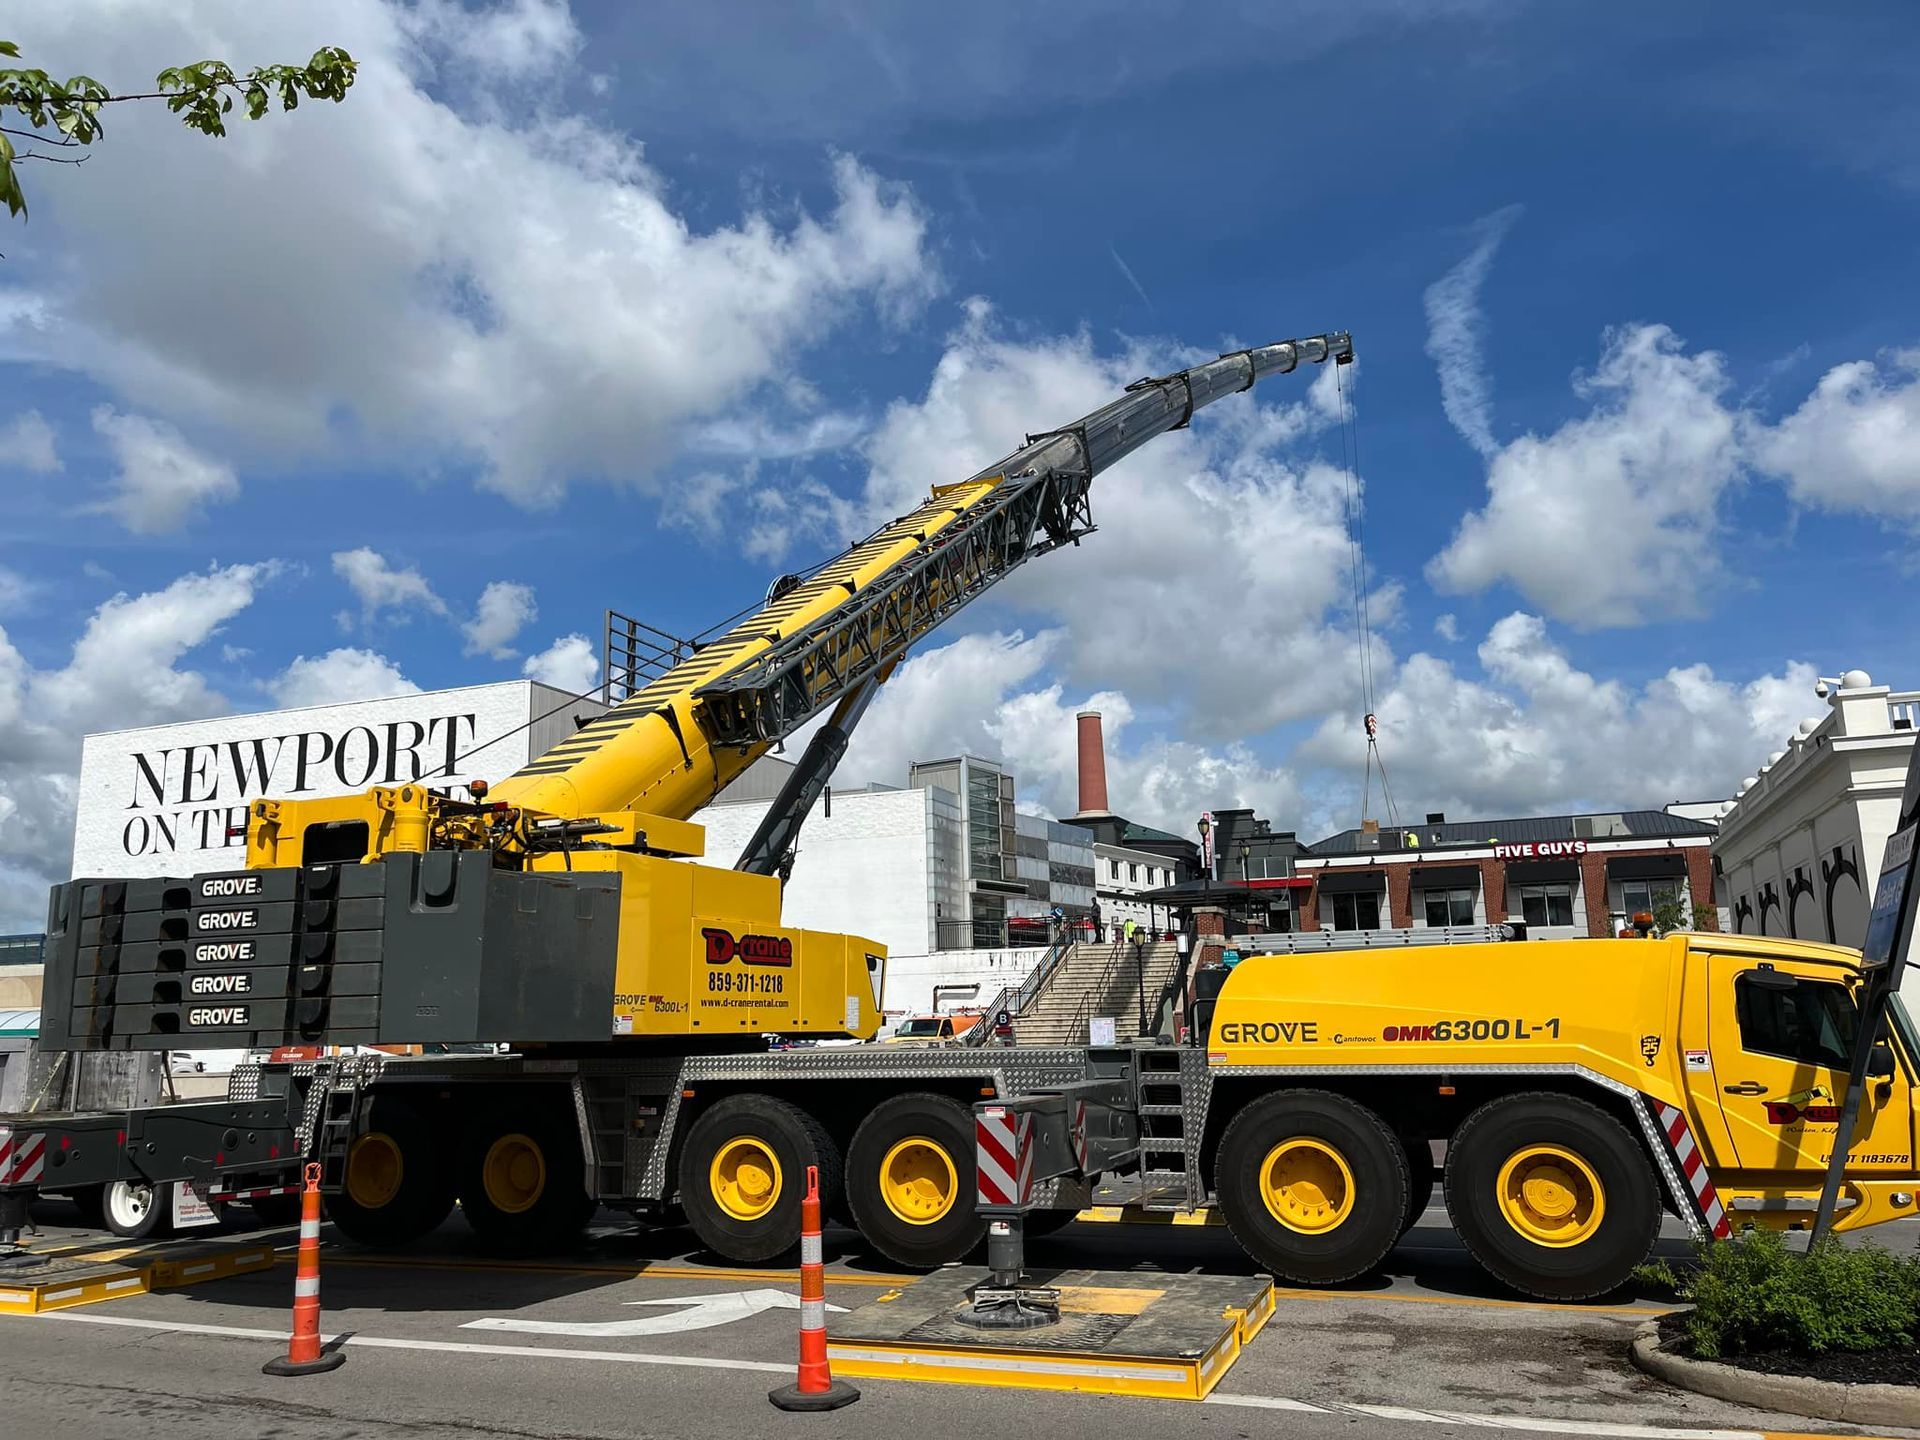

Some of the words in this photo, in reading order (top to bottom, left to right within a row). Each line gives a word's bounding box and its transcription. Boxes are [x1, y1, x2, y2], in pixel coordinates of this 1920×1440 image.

[124, 714, 475, 809] NEWPORT
[123, 812, 180, 856] ON
[192, 806, 250, 850] TH
[1495, 844, 1533, 858] FIVE
[1538, 841, 1586, 855] GUYS
[202, 878, 257, 896] GROVE
[198, 911, 253, 929] GROVE
[196, 943, 251, 961] GROVE
[191, 976, 247, 993] GROVE
[709, 972, 783, 993] 859-371-1218
[614, 994, 646, 1005] GROVE
[654, 1002, 689, 1013] 6300L-1
[700, 998, 789, 1008] www.d-cranerental.com
[189, 1008, 245, 1025] GROVE
[999, 1014, 1007, 1024] B
[1220, 1022, 1318, 1044] GROVE
[1642, 1042, 1658, 1055] 25
[1861, 1154, 1909, 1164] 1183678
